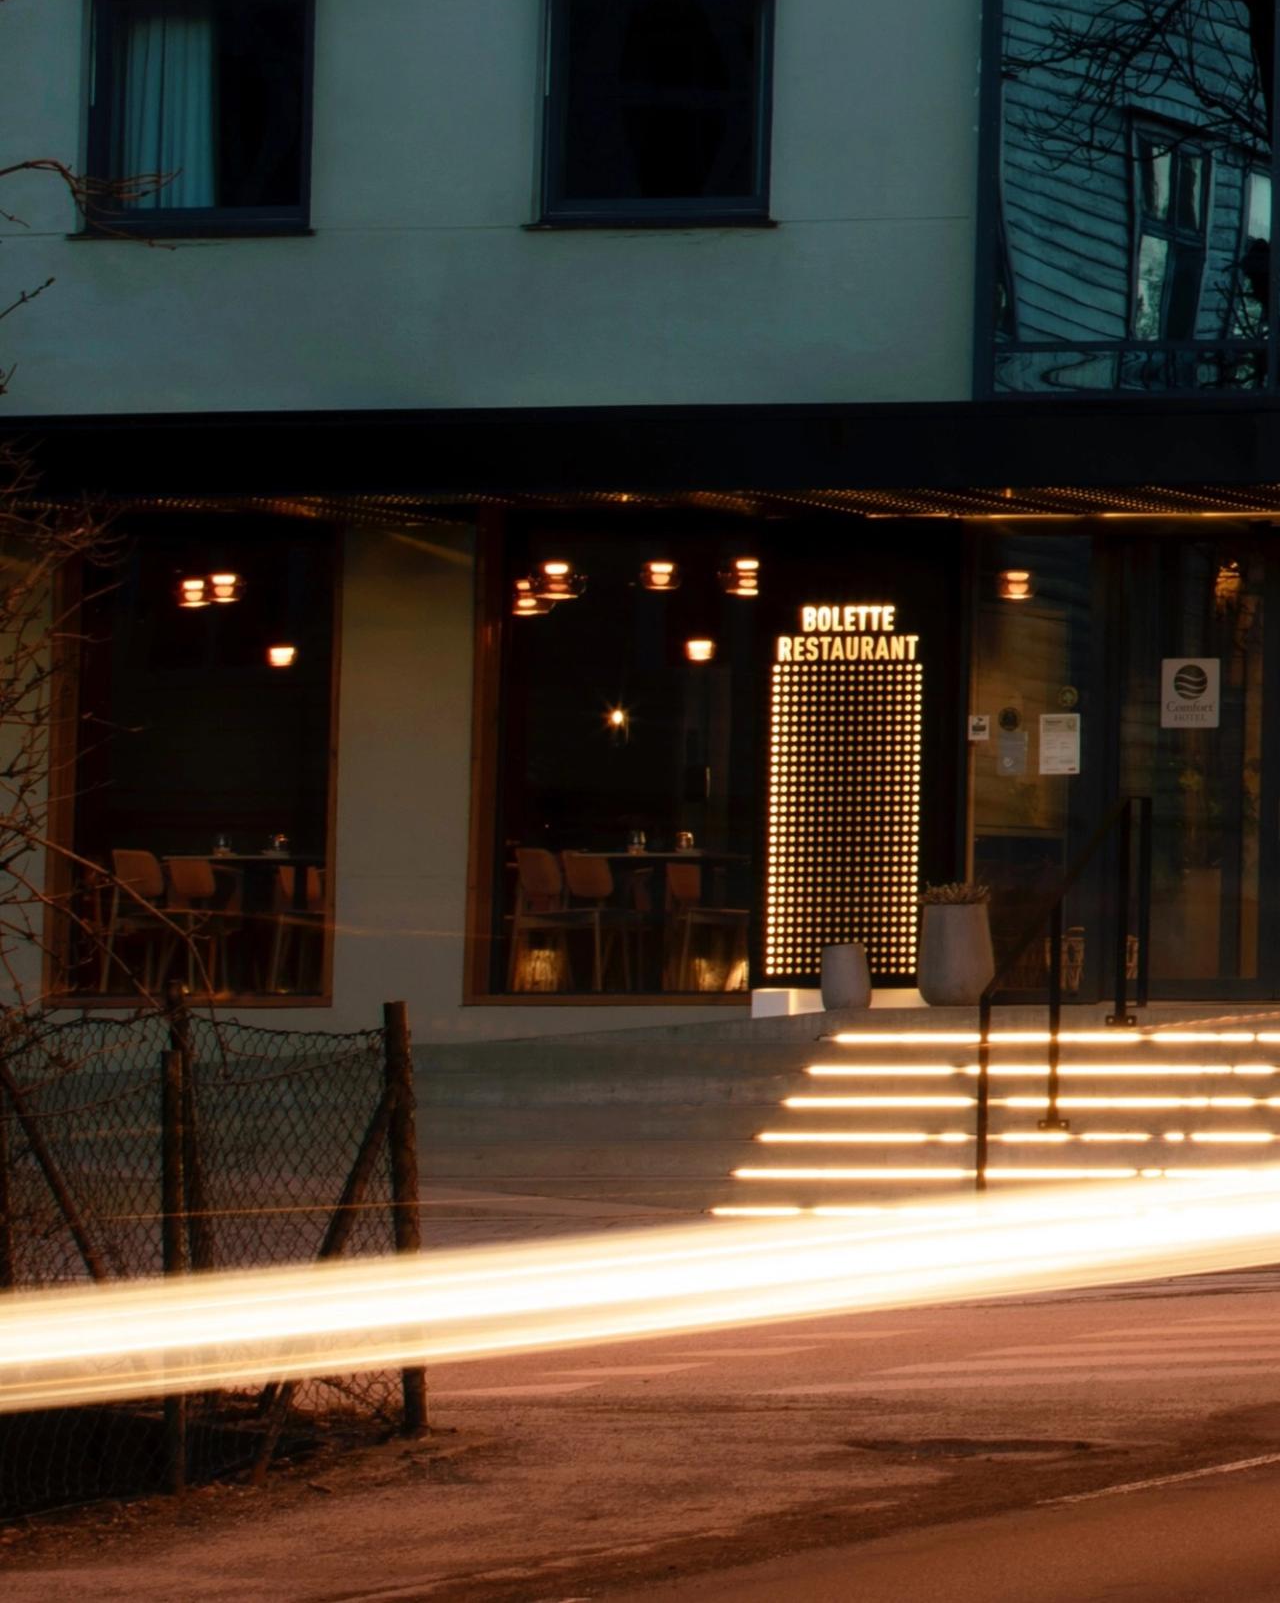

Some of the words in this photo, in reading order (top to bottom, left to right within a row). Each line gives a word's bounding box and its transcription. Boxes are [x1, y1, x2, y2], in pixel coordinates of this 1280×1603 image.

[802, 605, 896, 632] BOLETTE
[777, 635, 919, 662] RESTAURANT
[1166, 700, 1214, 713] Comfort
